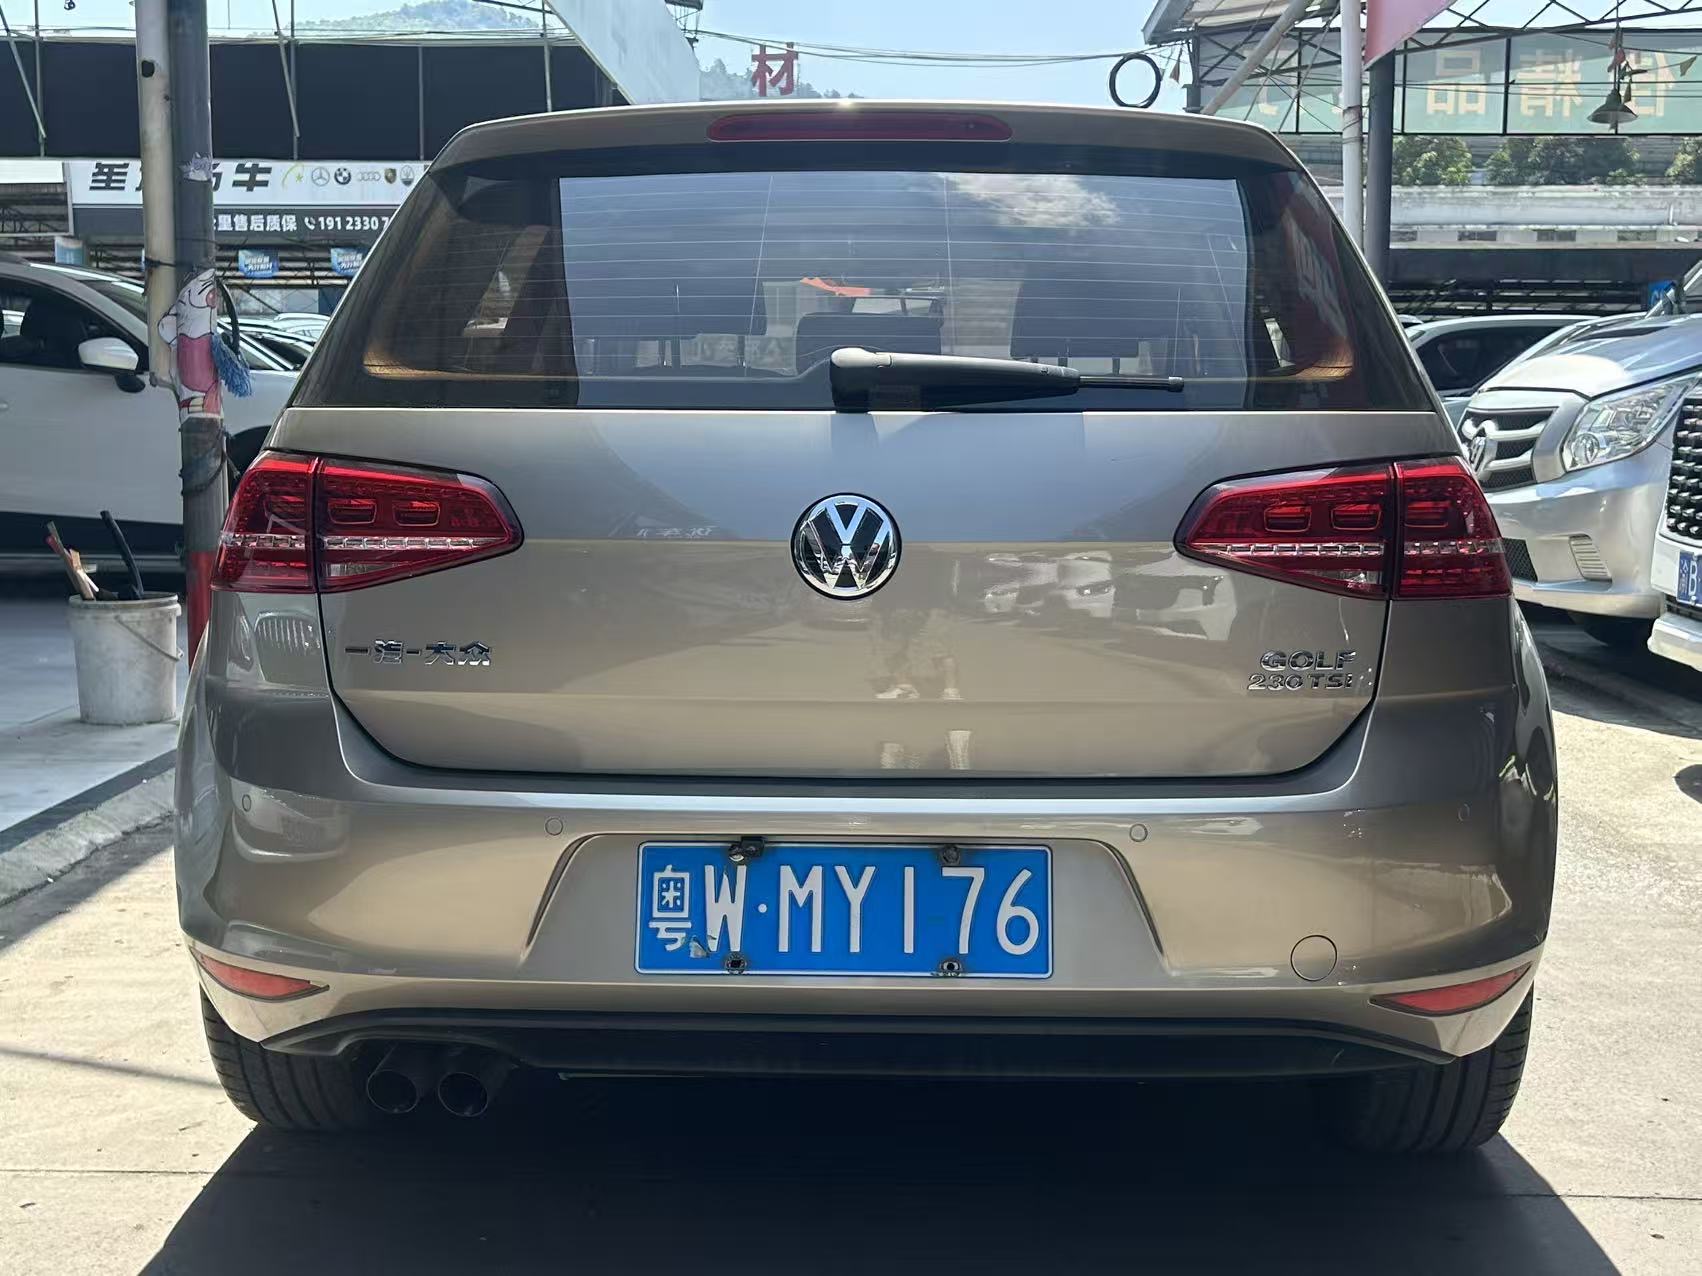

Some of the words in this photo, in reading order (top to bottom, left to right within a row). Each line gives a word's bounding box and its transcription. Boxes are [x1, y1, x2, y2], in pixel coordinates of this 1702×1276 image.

[751, 41, 799, 97] 材
[212, 214, 297, 232] 里售后质保
[319, 216, 342, 231] 191
[346, 216, 379, 231] 2330
[1260, 649, 1357, 672] GOLF
[1247, 673, 1303, 691] 230
[1308, 672, 1353, 690] TSI
